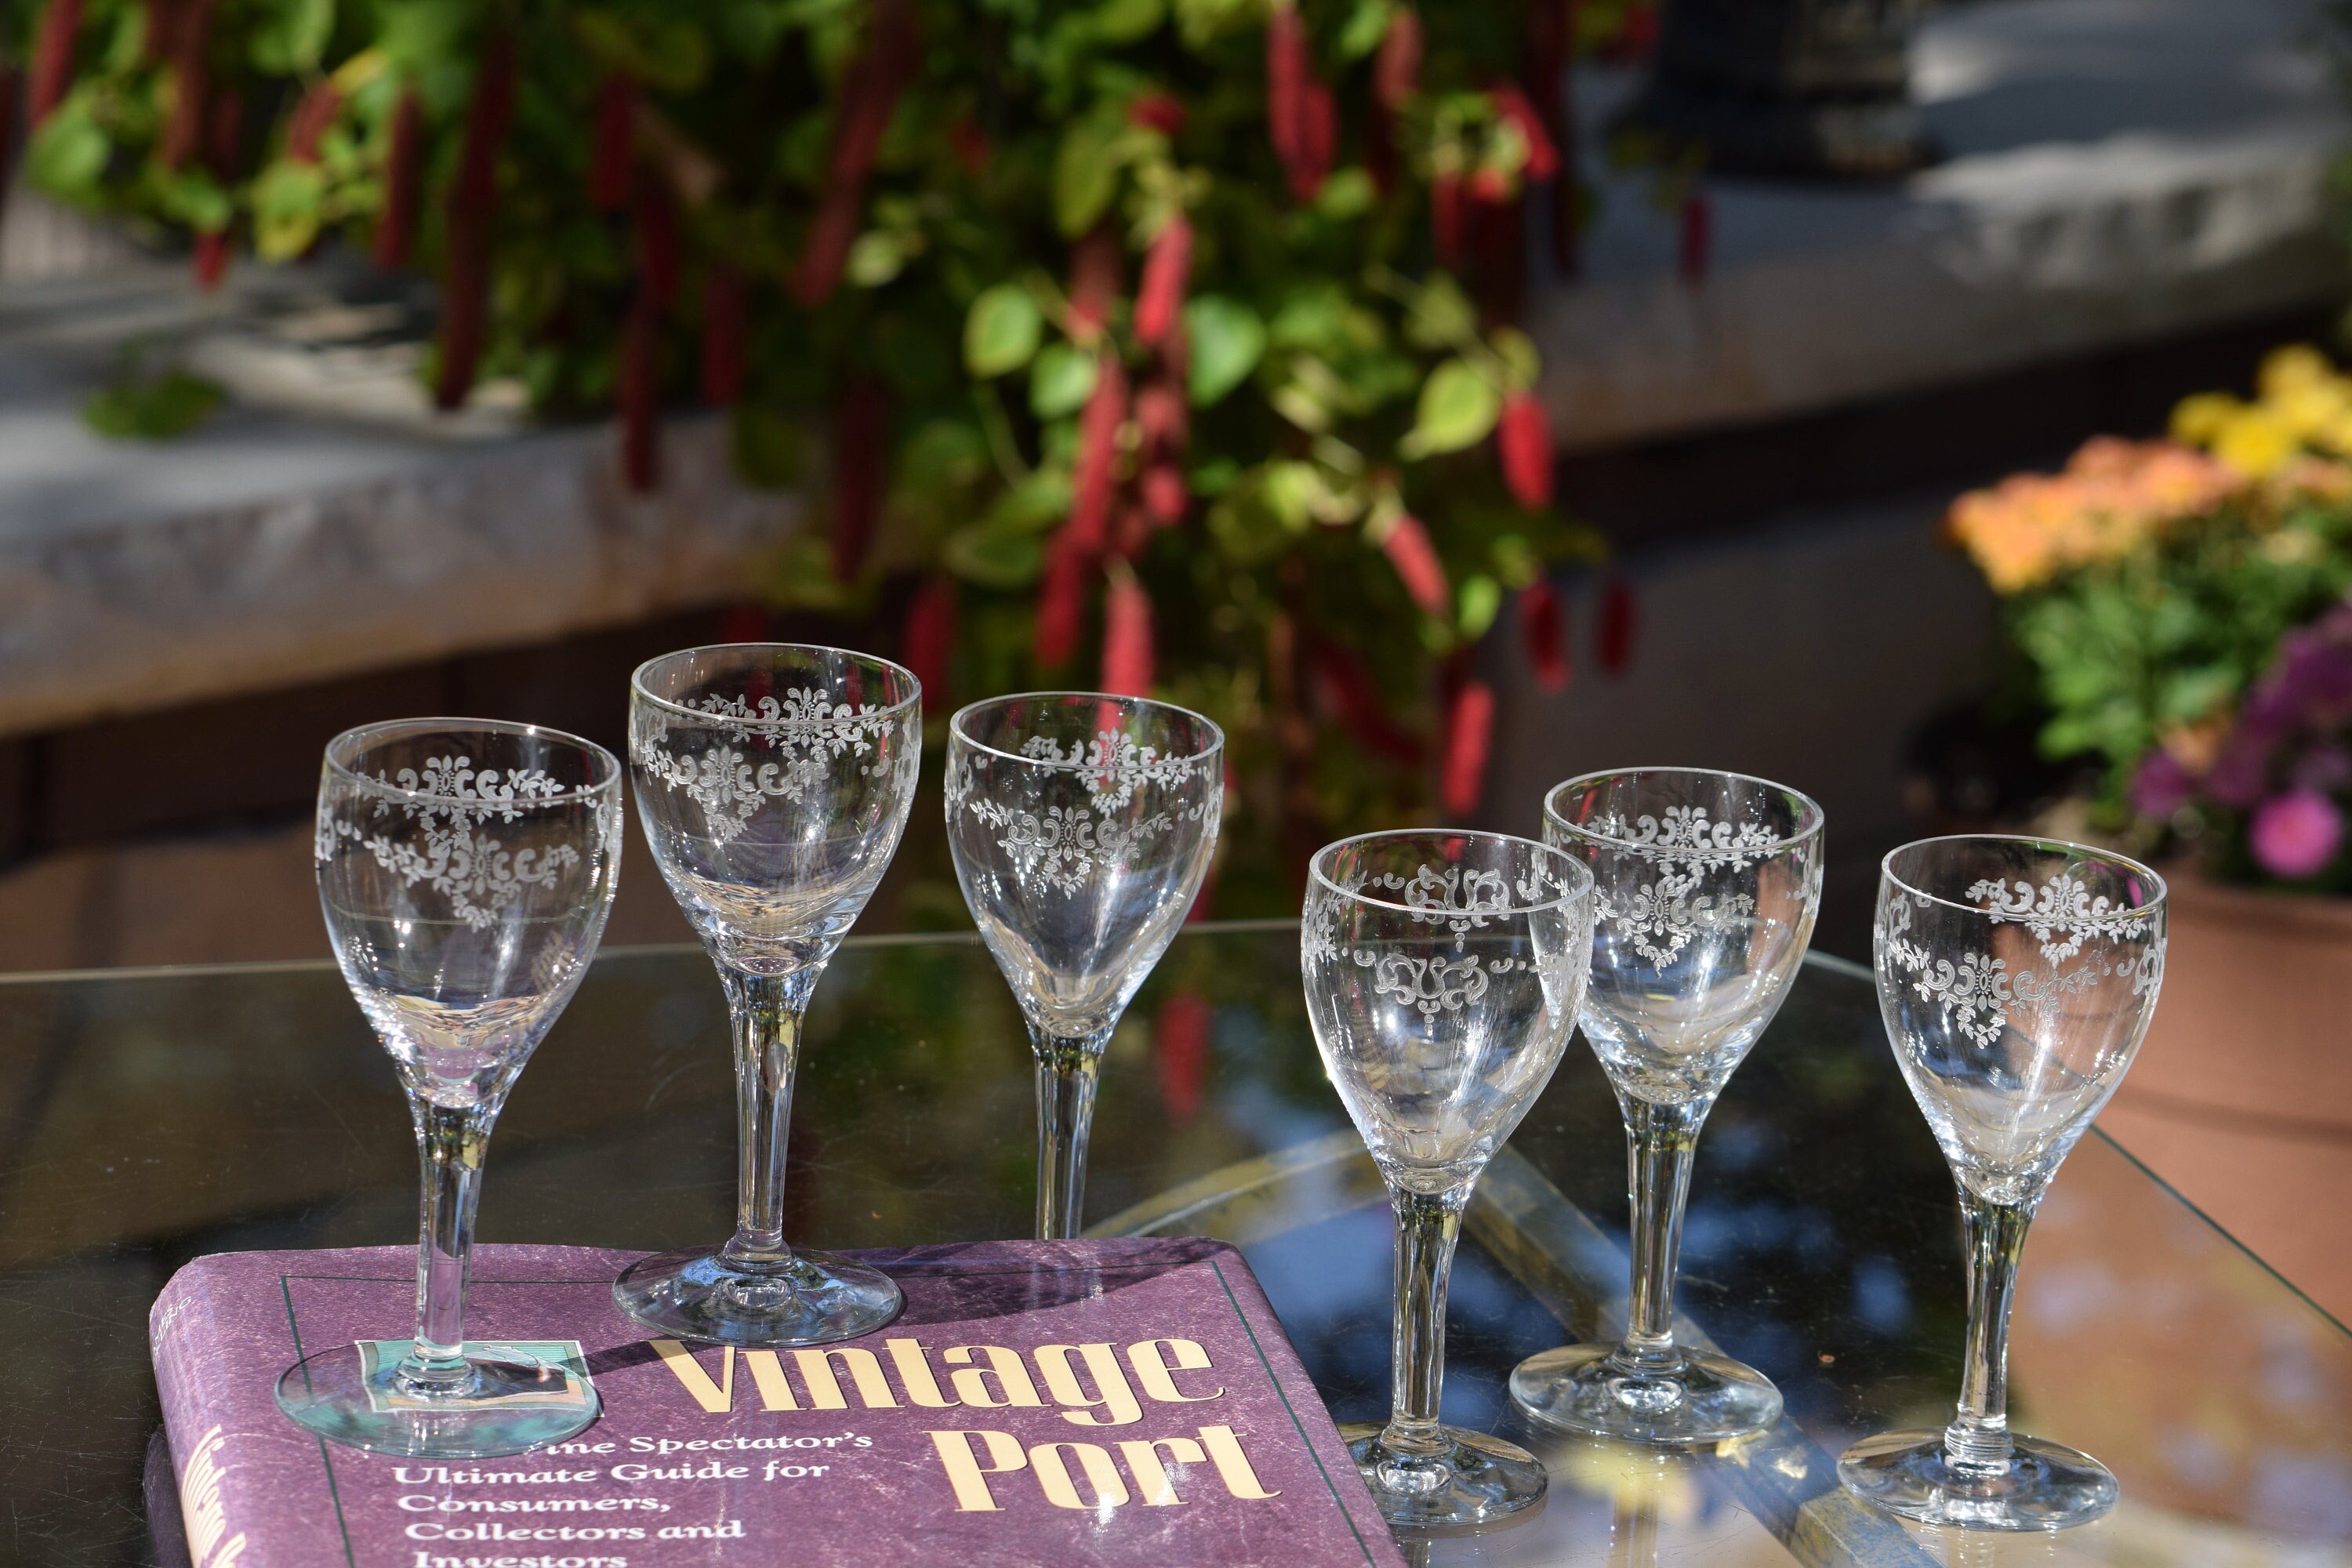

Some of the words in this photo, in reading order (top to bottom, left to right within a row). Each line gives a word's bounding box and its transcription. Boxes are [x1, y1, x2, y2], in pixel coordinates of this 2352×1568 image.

[639, 1338, 1225, 1426] Vintage
[546, 1443, 616, 1455] ine
[629, 1432, 873, 1454] Spectator’s
[391, 1467, 597, 1484] Ultimate
[611, 1461, 750, 1480] Guide
[762, 1461, 830, 1481] for
[922, 1425, 1283, 1512] Port
[397, 1494, 671, 1512] Consumers,
[405, 1523, 646, 1541] Collectors
[657, 1519, 746, 1540] and
[412, 1551, 629, 1568] Investors
